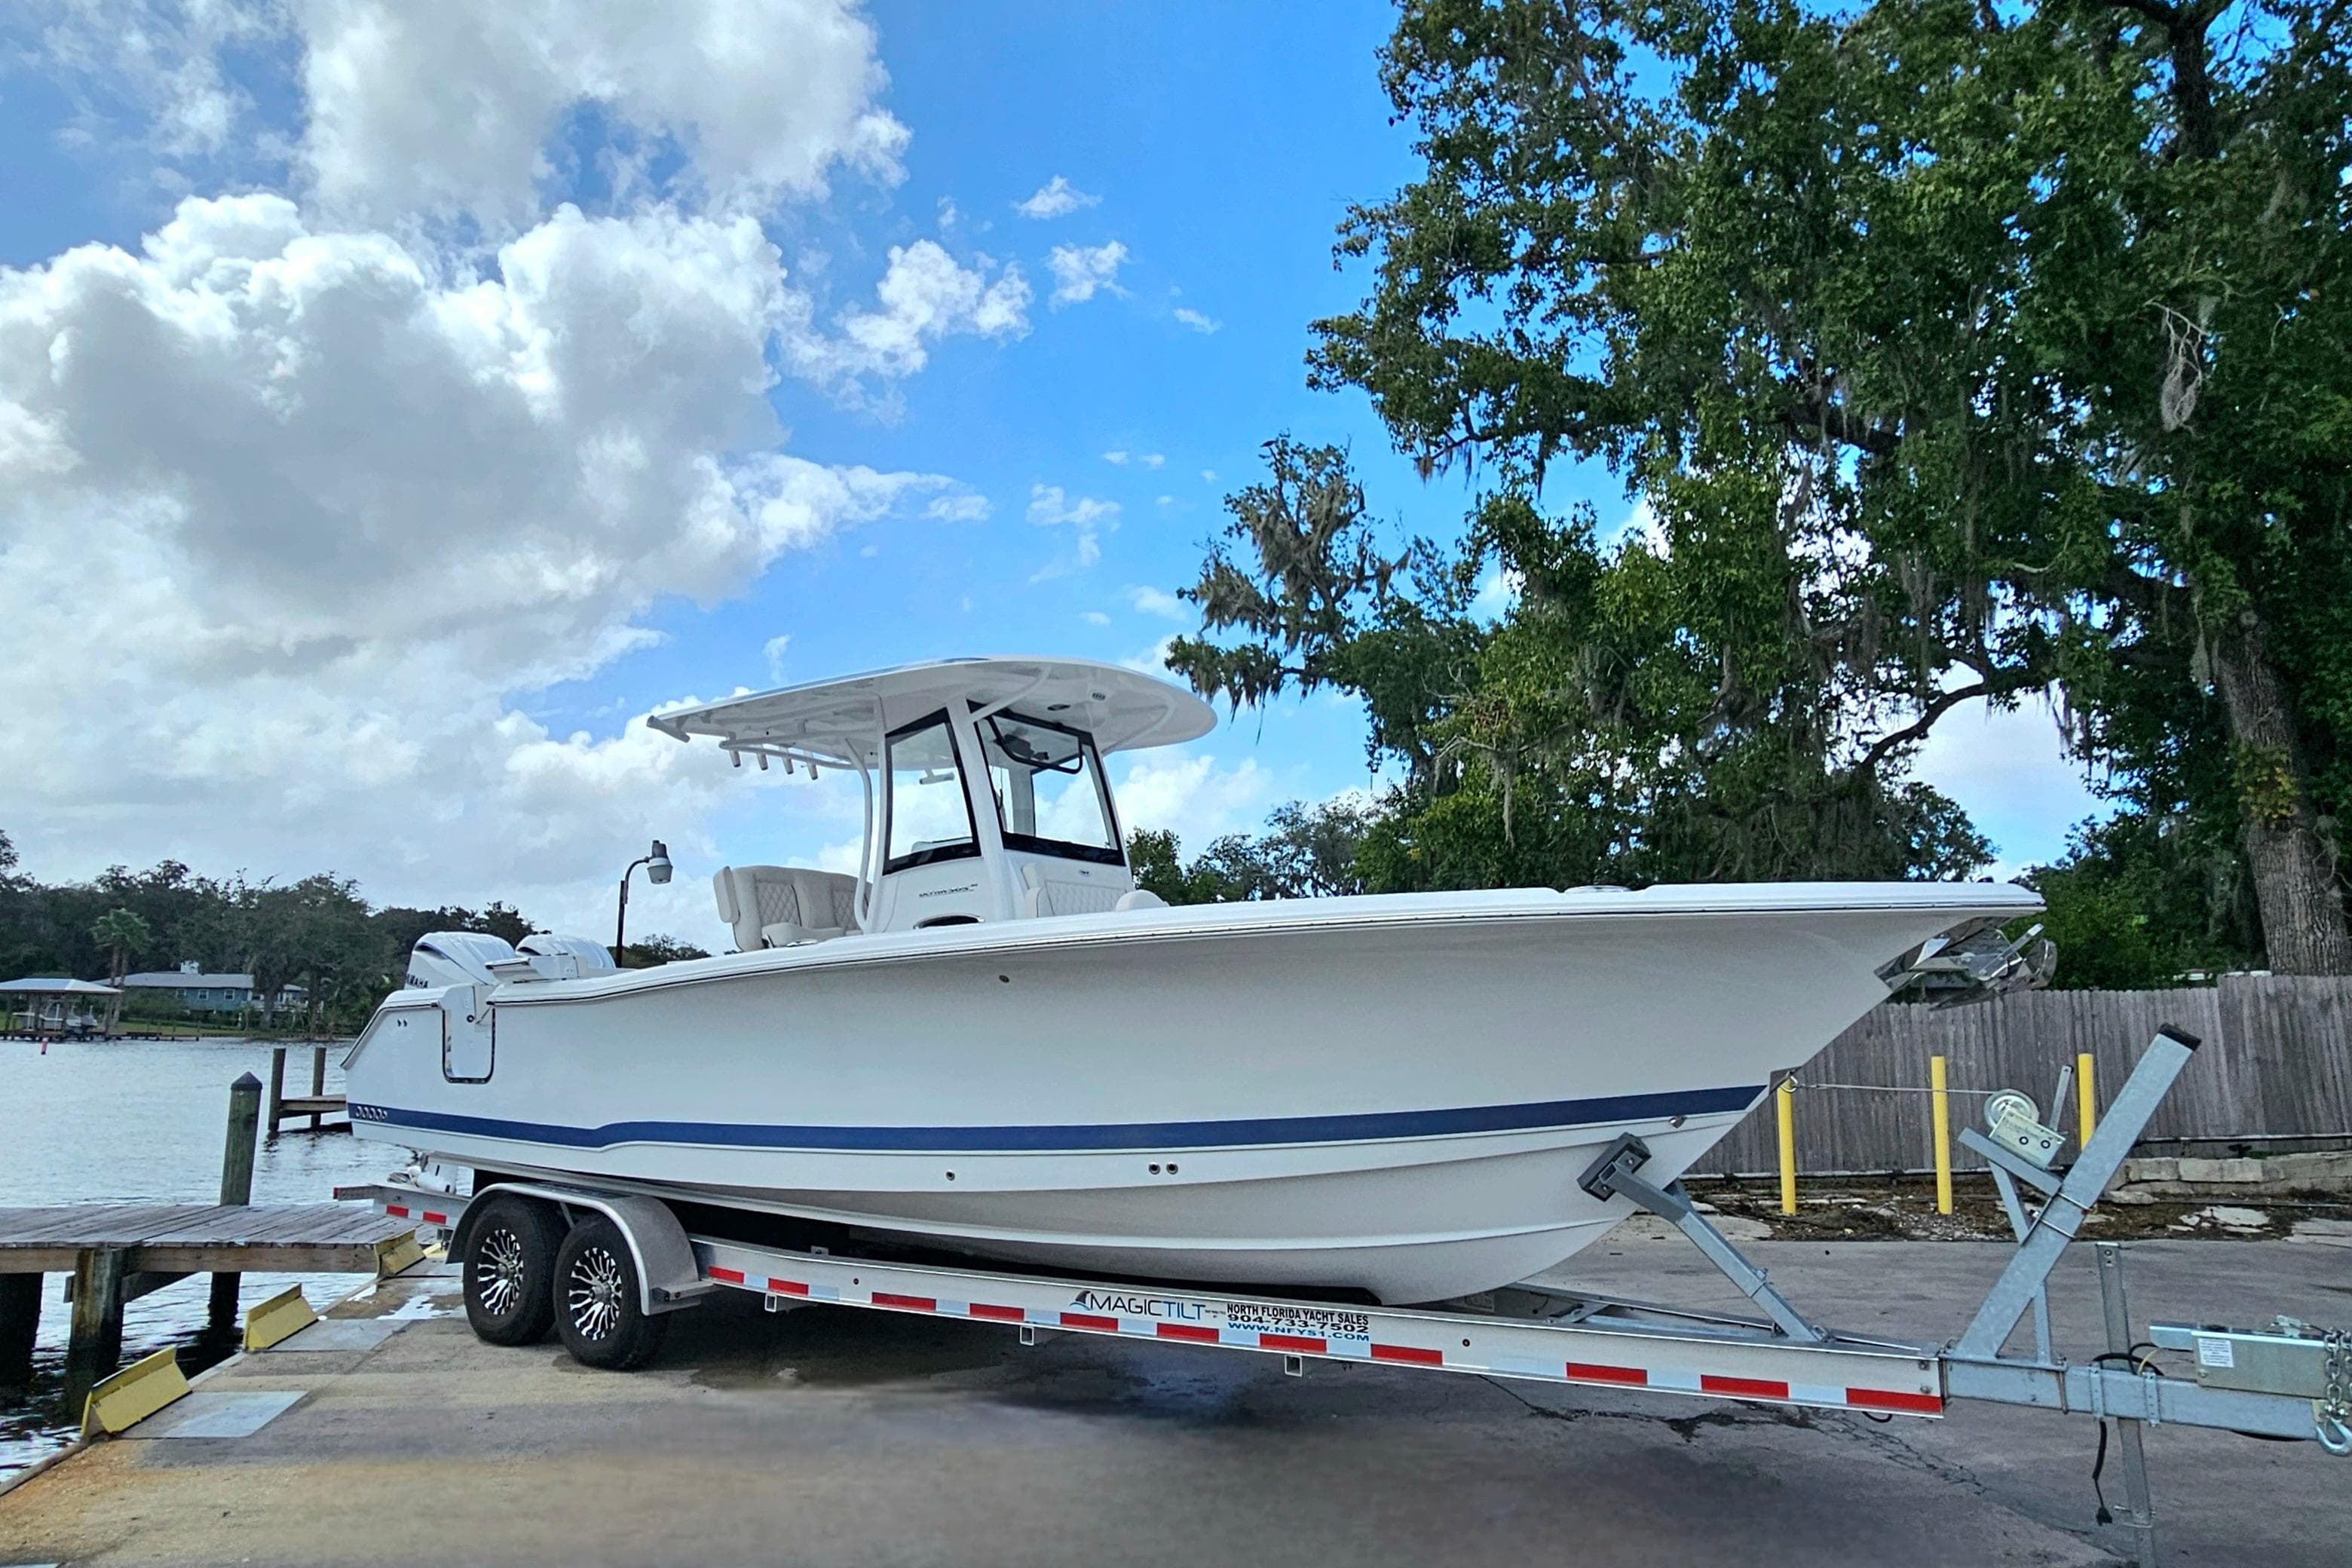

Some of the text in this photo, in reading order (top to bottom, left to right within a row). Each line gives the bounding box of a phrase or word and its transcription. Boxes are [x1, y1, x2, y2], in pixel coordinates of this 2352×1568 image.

[1090, 1293, 1206, 1320] MAGICTILT
[1227, 1303, 1258, 1315] NORTH
[1261, 1306, 1300, 1320] FLORIDA
[1301, 1309, 1335, 1323] YACHT
[1338, 1313, 1369, 1326] SALES
[1227, 1314, 1369, 1334] 904-733-7502
[1227, 1322, 1370, 1342] WWW.NFYS1.COM
